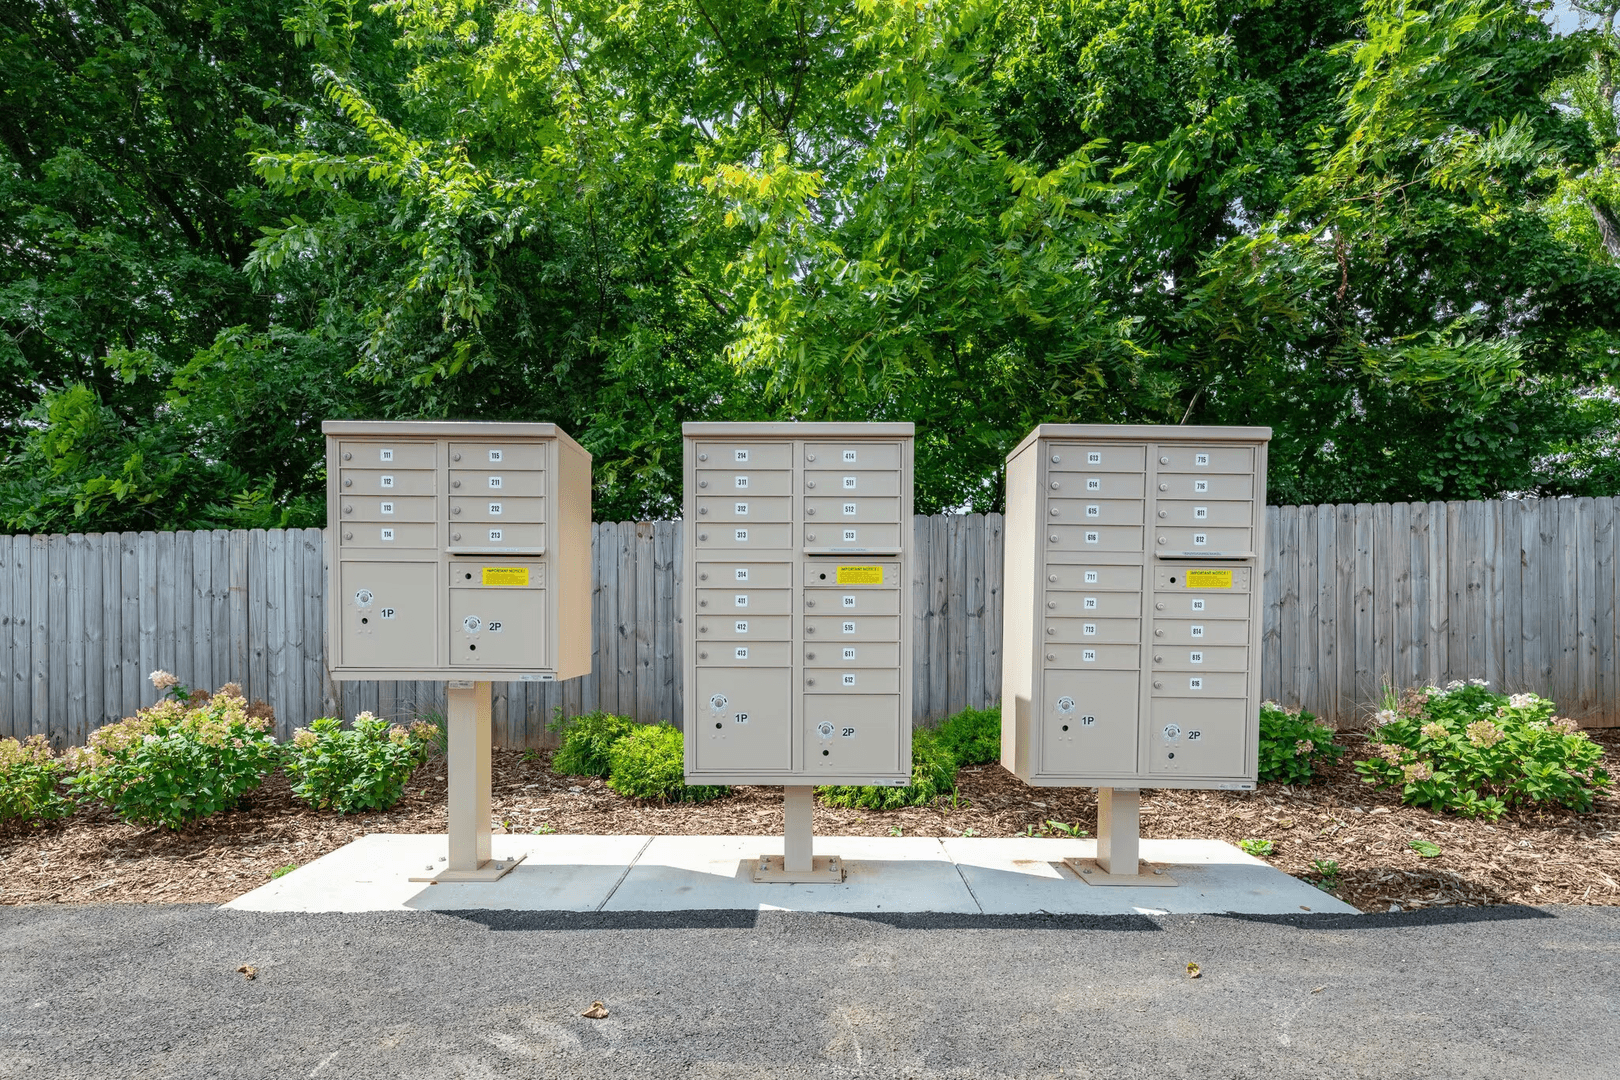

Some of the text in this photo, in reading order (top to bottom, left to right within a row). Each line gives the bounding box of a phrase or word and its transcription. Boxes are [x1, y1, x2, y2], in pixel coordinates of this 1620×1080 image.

[383, 451, 391, 459] 111
[491, 452, 500, 460] 115
[738, 478, 747, 486] 311
[845, 479, 854, 487] 511
[383, 504, 392, 512] 113
[845, 505, 855, 513] 512
[1197, 509, 1205, 517] 811
[491, 531, 501, 539] 213
[737, 531, 747, 539] 313
[1087, 573, 1096, 581] 711
[1086, 599, 1095, 607] 712
[381, 609, 394, 618] 1P
[489, 622, 502, 631] 2P
[737, 623, 747, 631] 412
[737, 649, 747, 657] 413
[844, 676, 854, 684] 612
[735, 713, 748, 723] 1P
[1082, 716, 1095, 725] 1P
[842, 728, 855, 737] 2P
[1188, 731, 1201, 740] 2P
